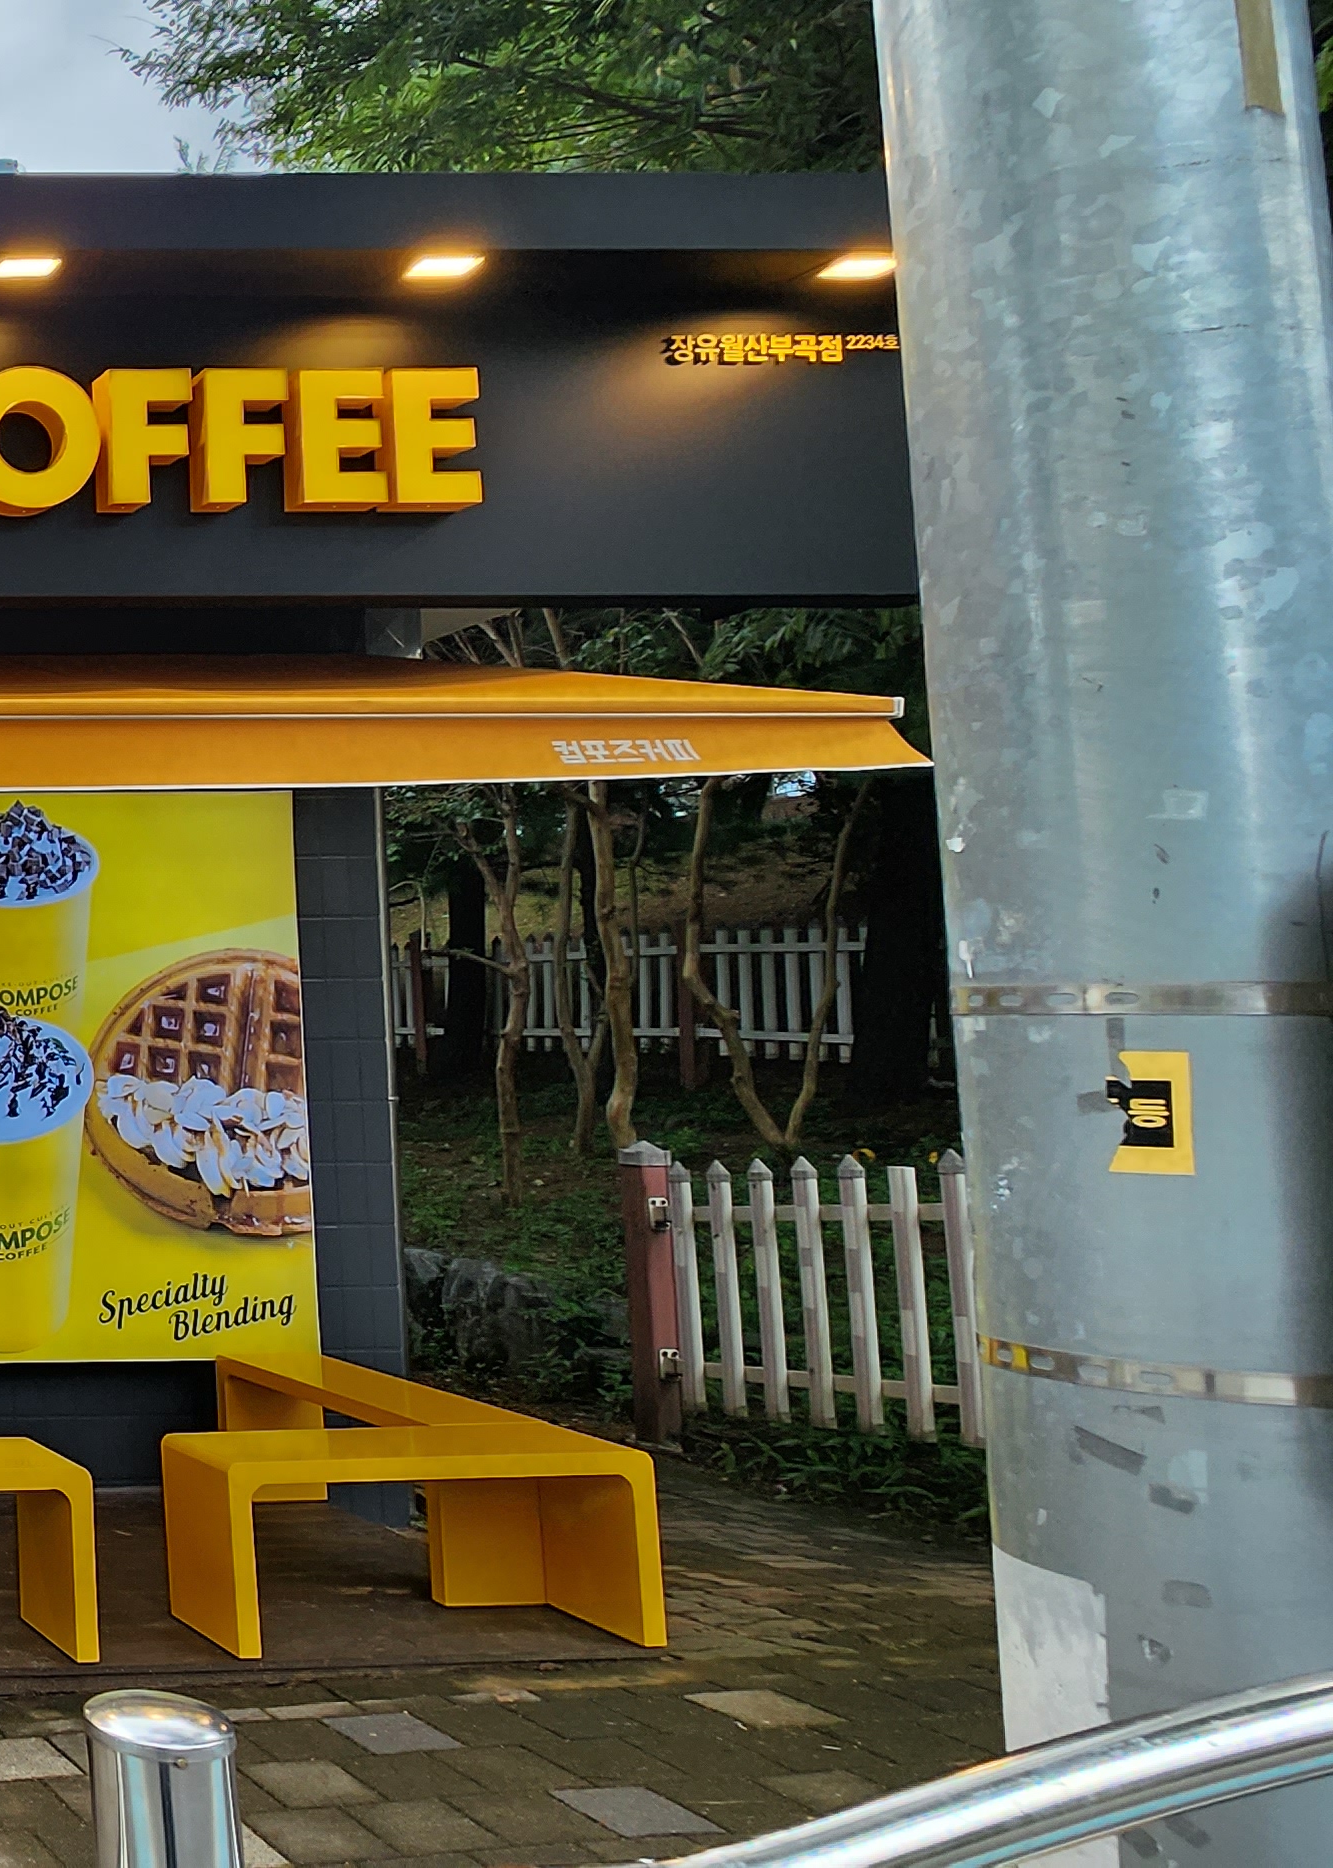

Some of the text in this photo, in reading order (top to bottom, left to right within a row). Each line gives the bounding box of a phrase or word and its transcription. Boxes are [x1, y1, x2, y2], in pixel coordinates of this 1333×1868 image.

[670, 333, 900, 362] 장유월산부곡점 2234호
[551, 738, 702, 764] 컴포즈커피
[15, 1003, 58, 1016] COFFEE
[98, 1272, 228, 1330] Specialty
[168, 1294, 296, 1341] Blending
